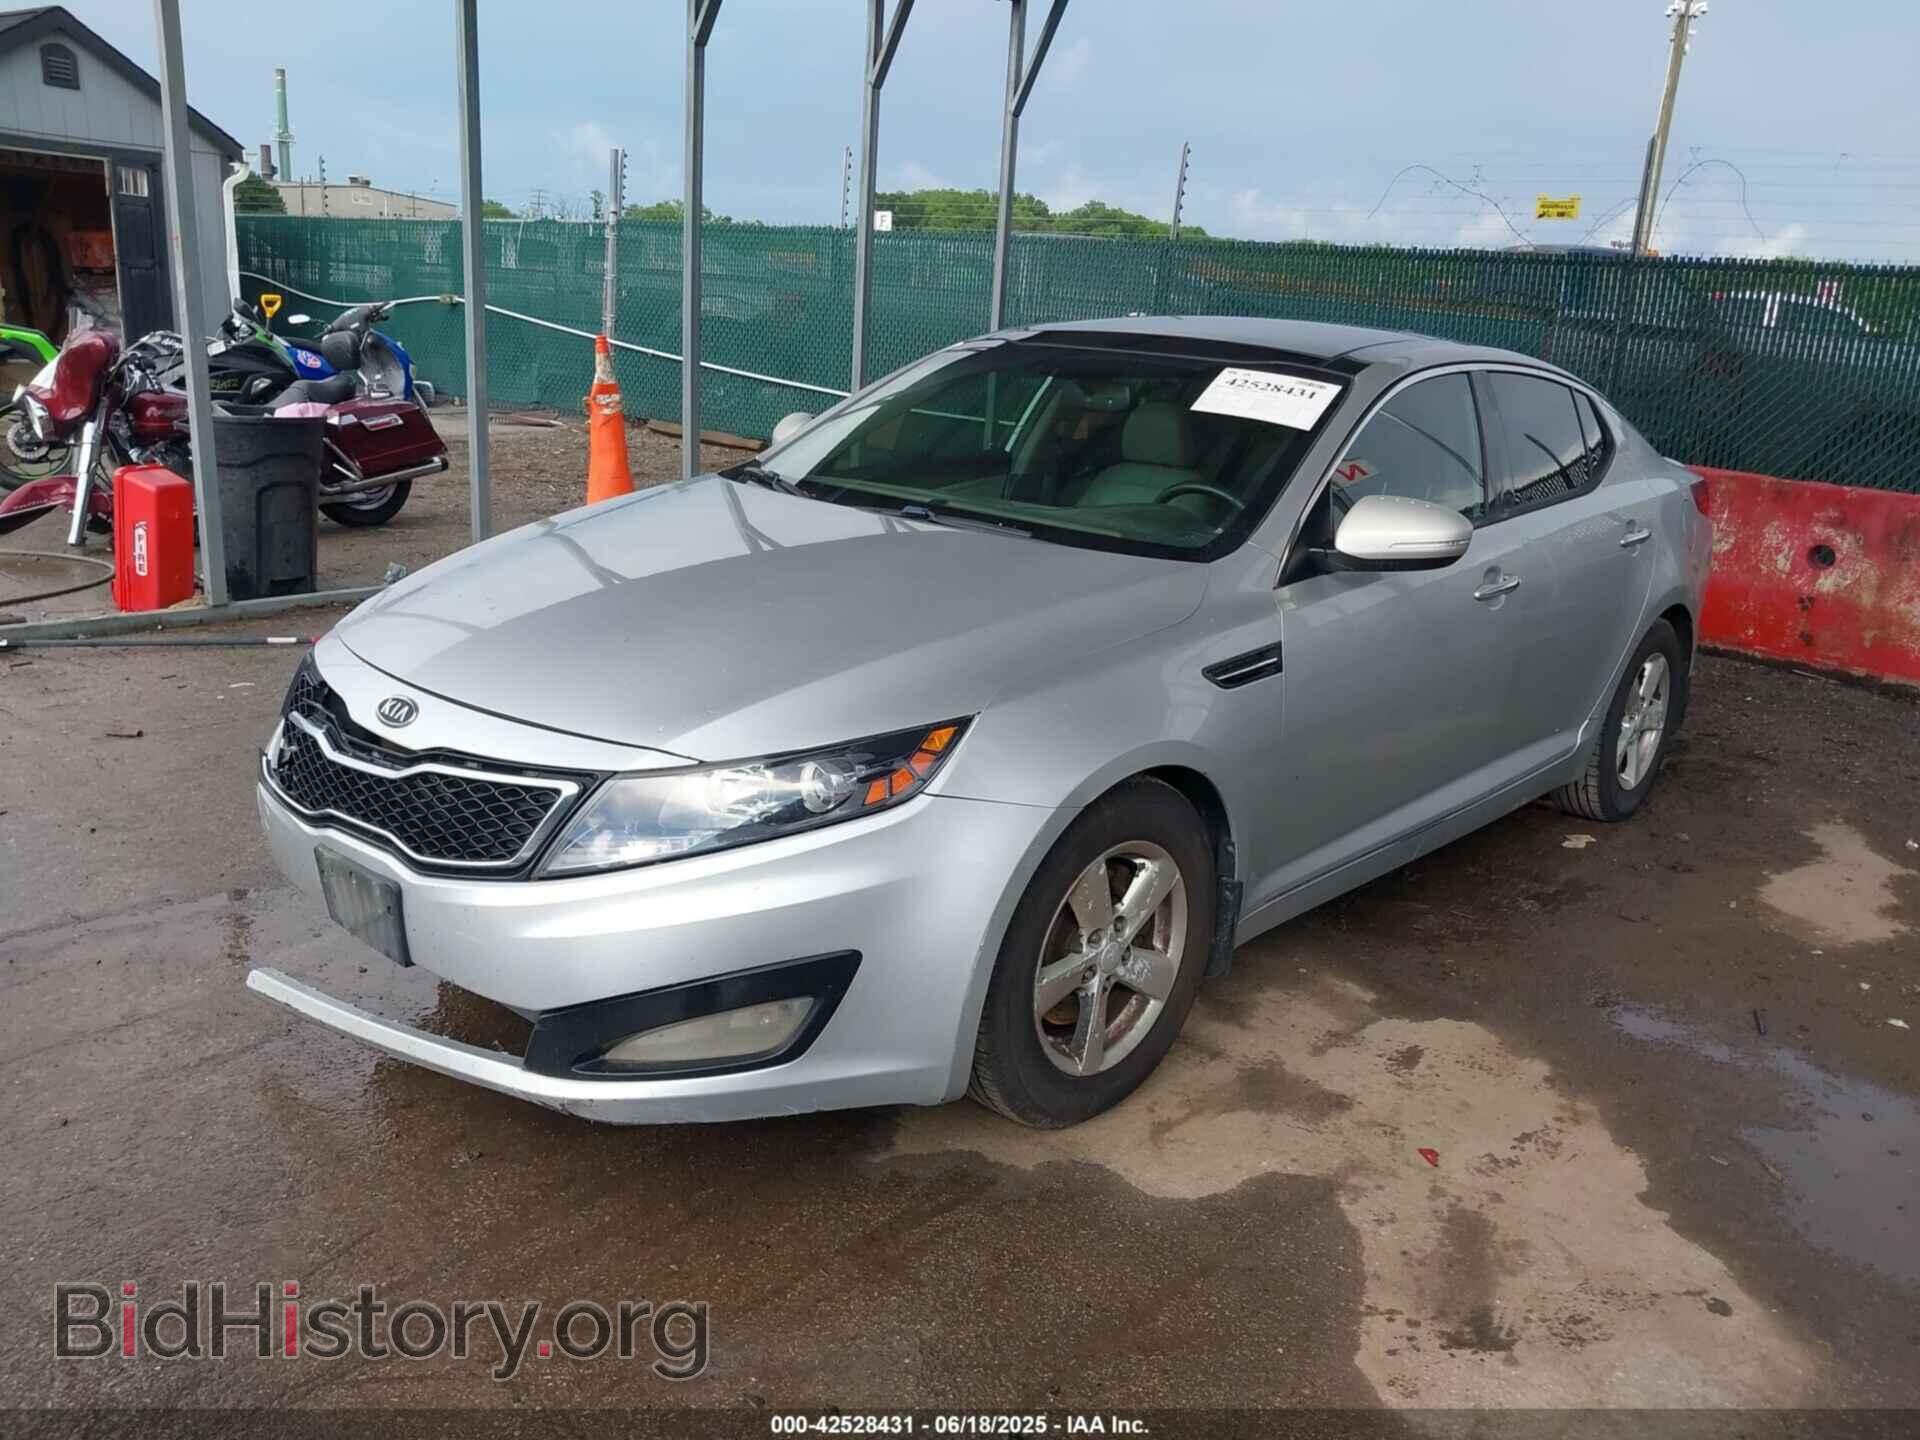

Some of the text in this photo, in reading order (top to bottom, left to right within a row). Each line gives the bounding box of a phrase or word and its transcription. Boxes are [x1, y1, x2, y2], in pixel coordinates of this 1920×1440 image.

[1225, 378, 1316, 400] 42528431
[137, 534, 146, 573] FIRE
[380, 699, 409, 722] KIA
